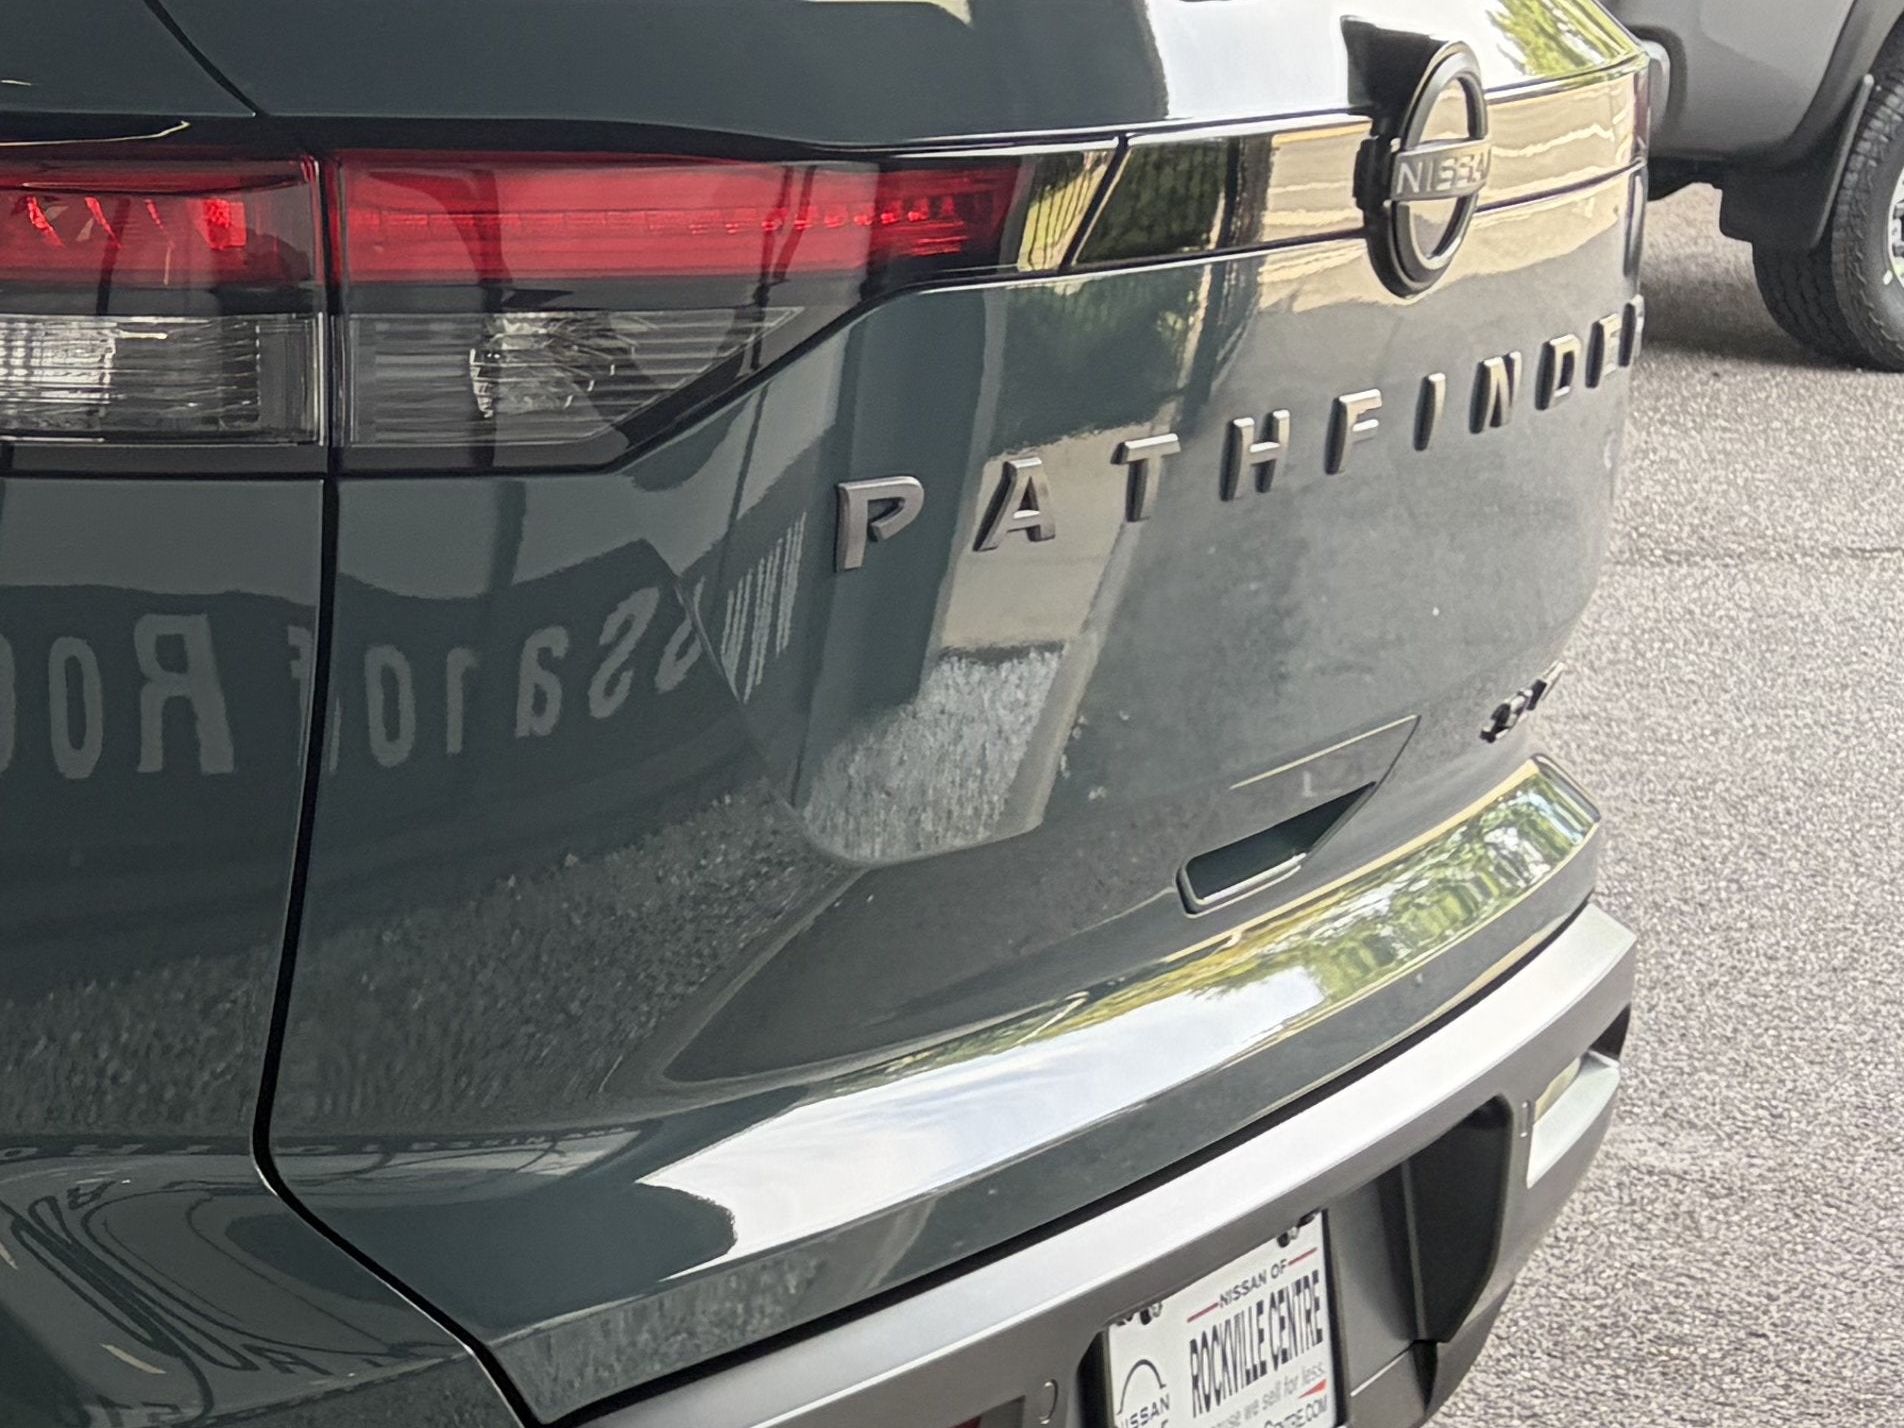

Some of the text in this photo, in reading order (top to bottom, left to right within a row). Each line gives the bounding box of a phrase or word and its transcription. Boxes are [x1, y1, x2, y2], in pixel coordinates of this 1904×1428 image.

[1219, 1258, 1288, 1308] NISSAN OF
[1189, 1269, 1324, 1419] ROCKVILLE CENTRE
[1243, 1399, 1260, 1421] we
